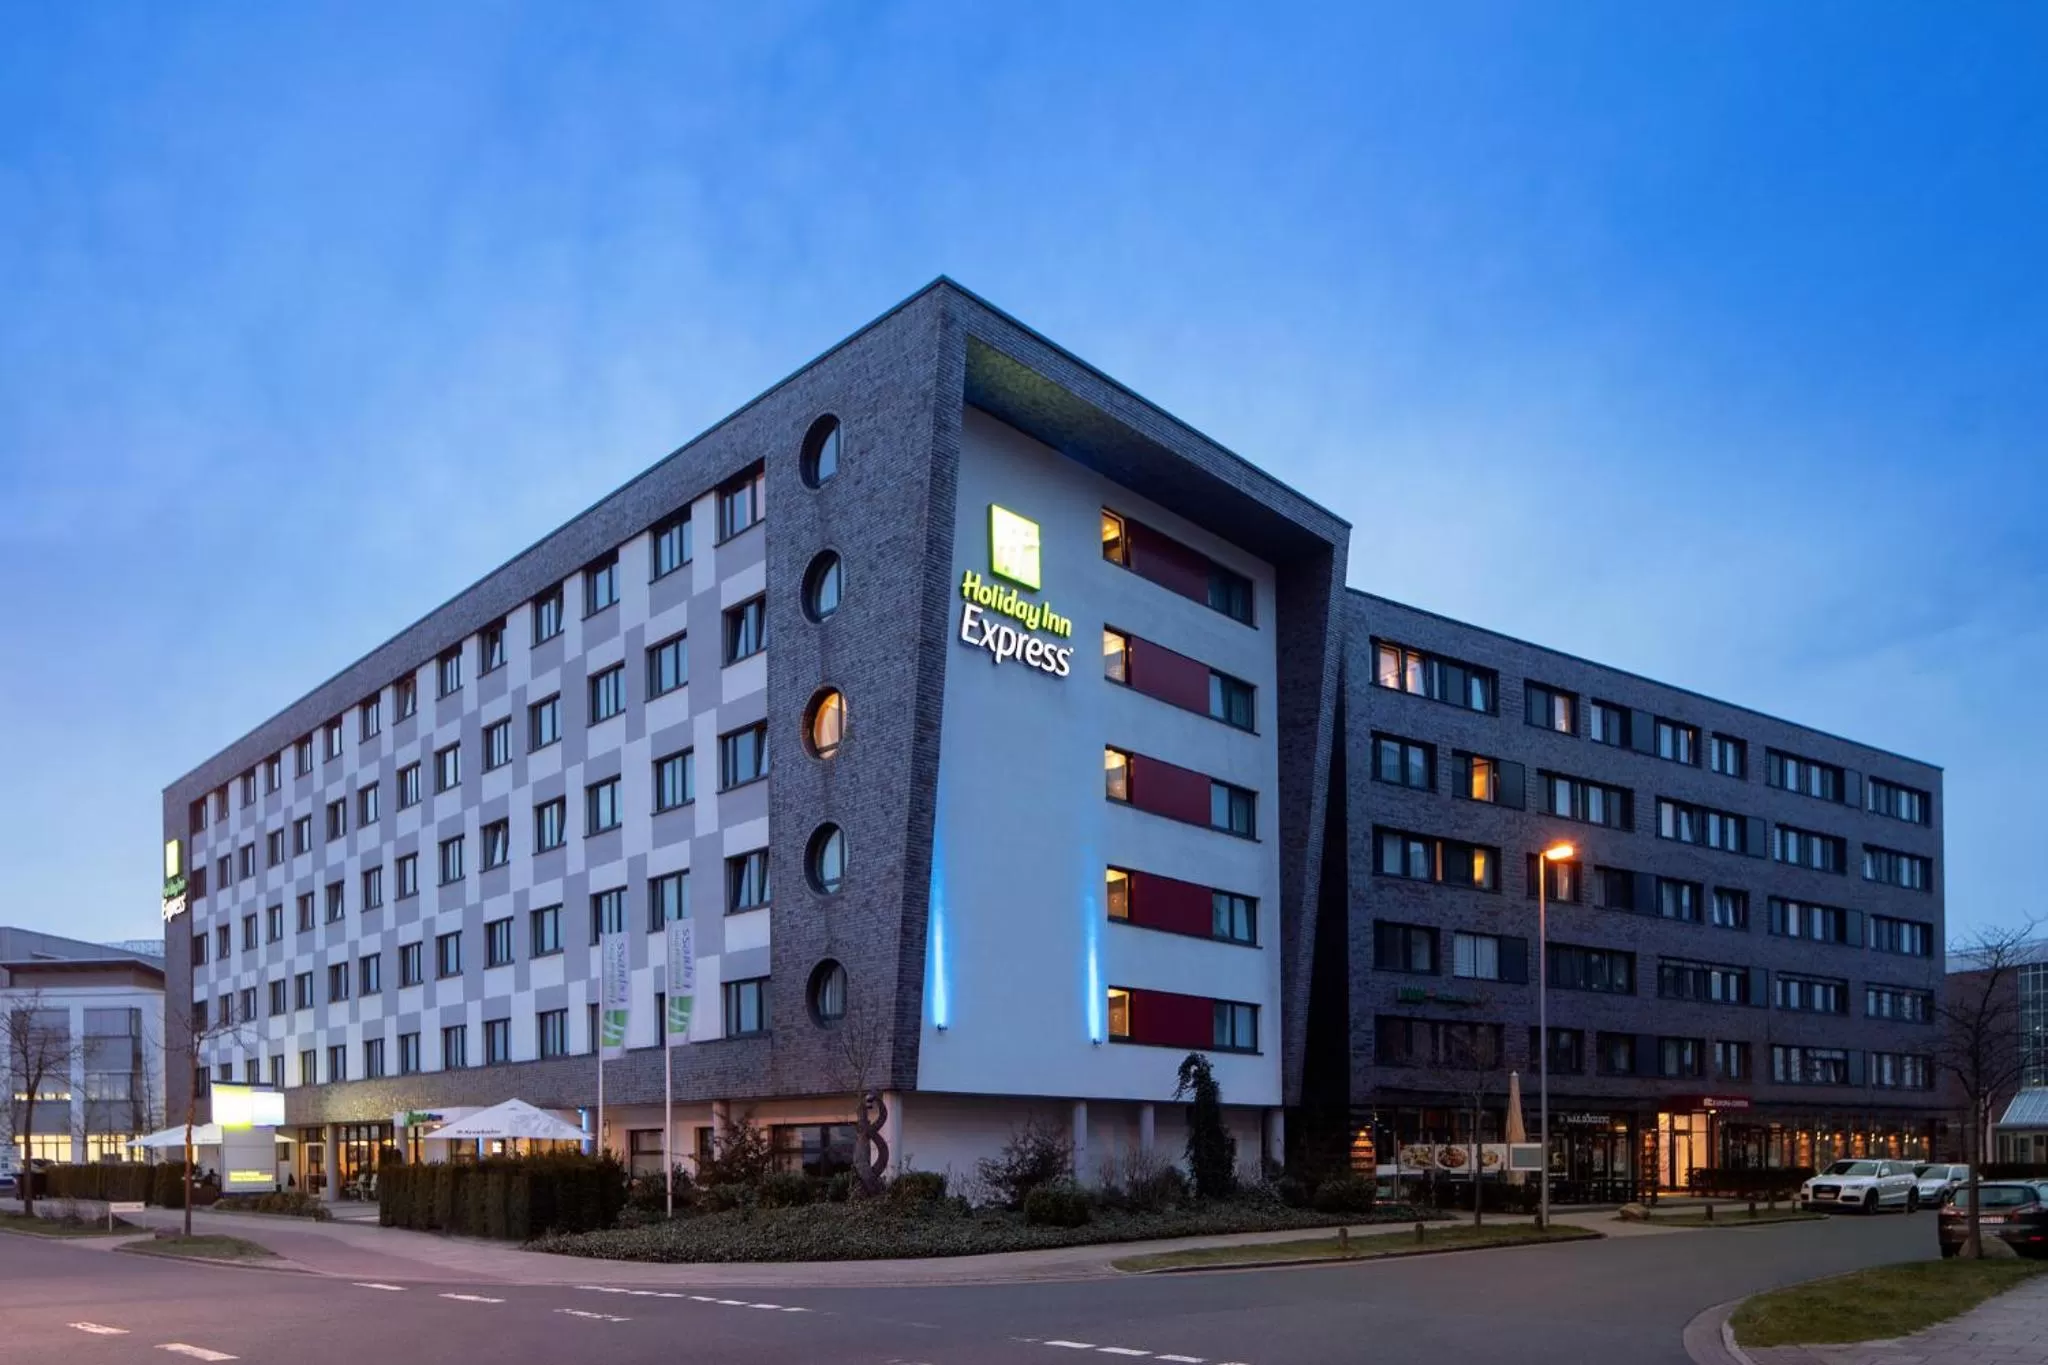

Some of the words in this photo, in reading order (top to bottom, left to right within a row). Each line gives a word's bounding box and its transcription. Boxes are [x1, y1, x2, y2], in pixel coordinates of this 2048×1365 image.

[962, 569, 1041, 630] Holiday
[1043, 601, 1072, 637] Inn
[961, 602, 1072, 677] Express
